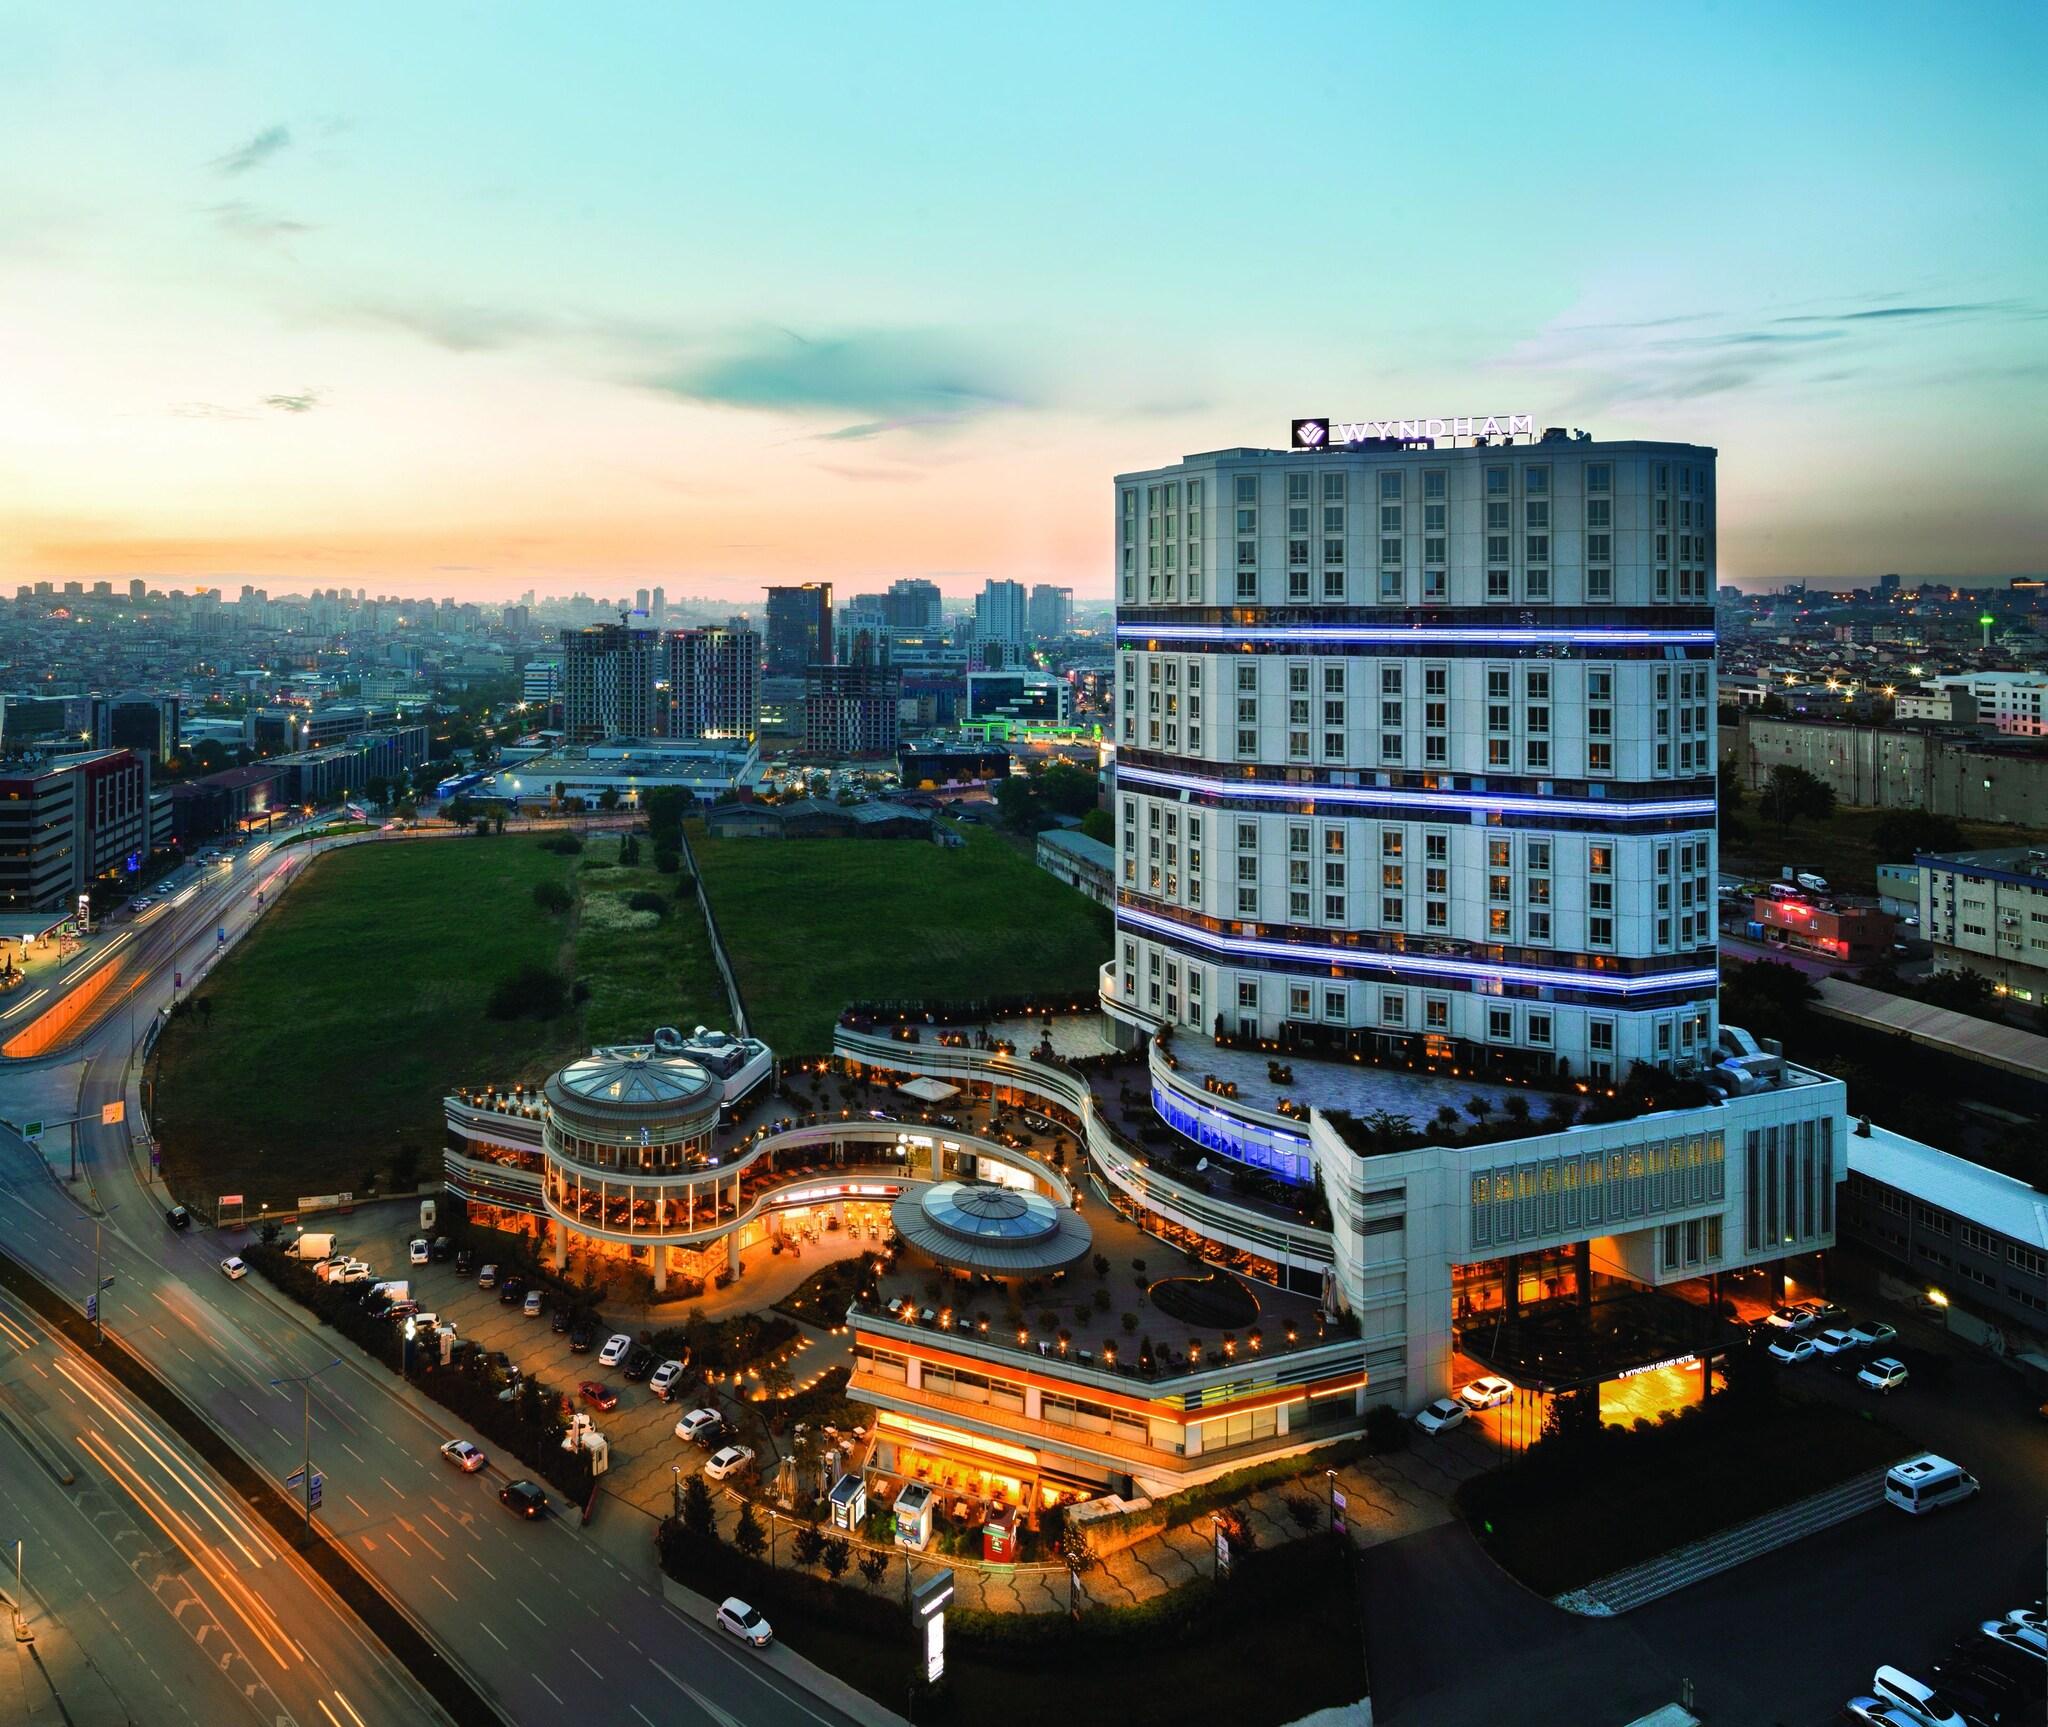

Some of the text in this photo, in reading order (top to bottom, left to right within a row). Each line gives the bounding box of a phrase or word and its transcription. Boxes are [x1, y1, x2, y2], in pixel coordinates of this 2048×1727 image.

[1338, 415, 1533, 443] WYNDHAM
[1625, 1355, 1696, 1377] WYNDHAM GRAND HOTEL
